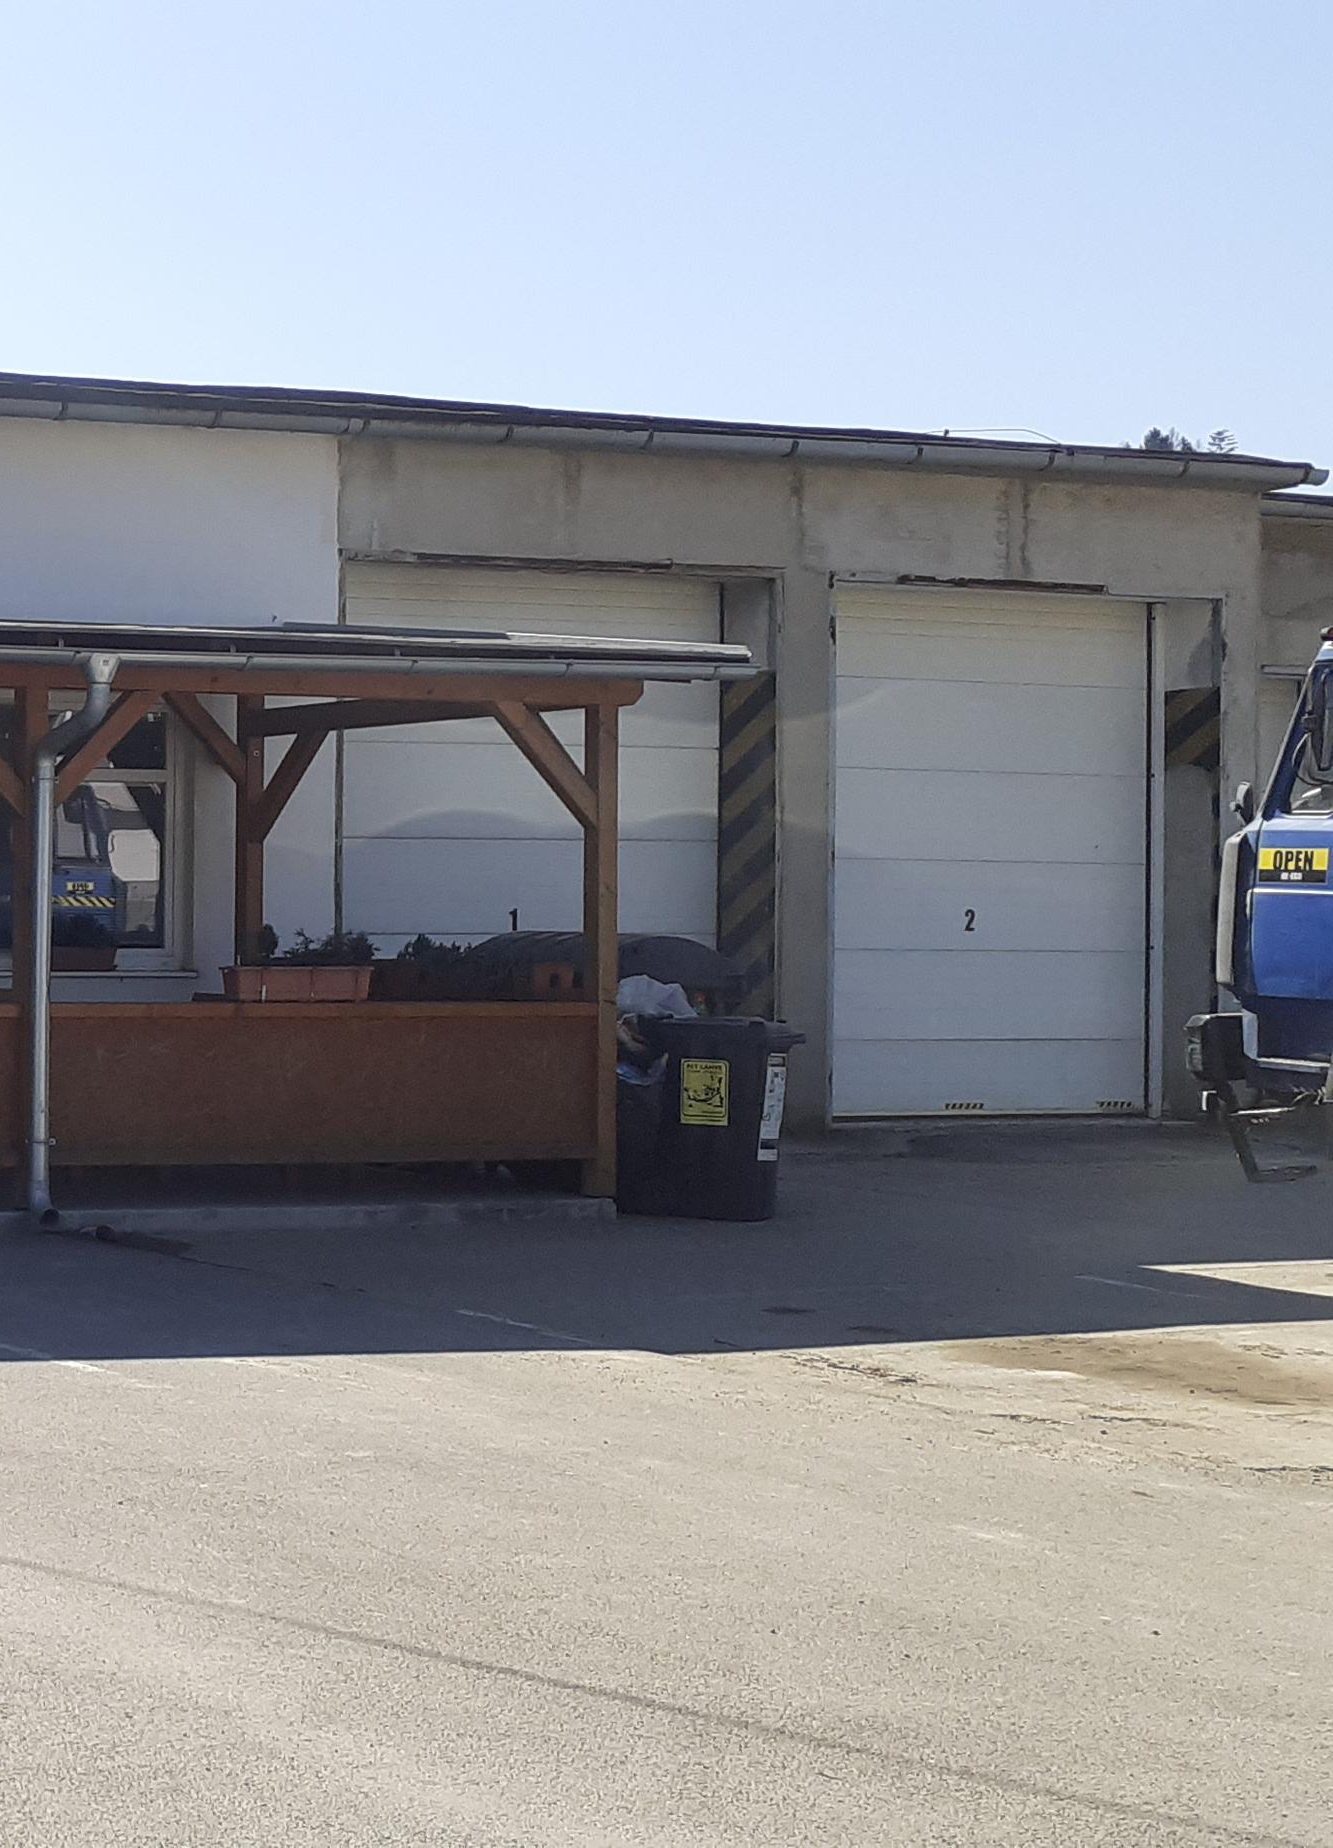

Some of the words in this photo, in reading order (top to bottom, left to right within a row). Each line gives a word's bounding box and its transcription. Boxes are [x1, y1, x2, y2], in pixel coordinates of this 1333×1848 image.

[1273, 850, 1314, 870] OPEN
[509, 908, 517, 931] 1
[965, 909, 975, 931] 2
